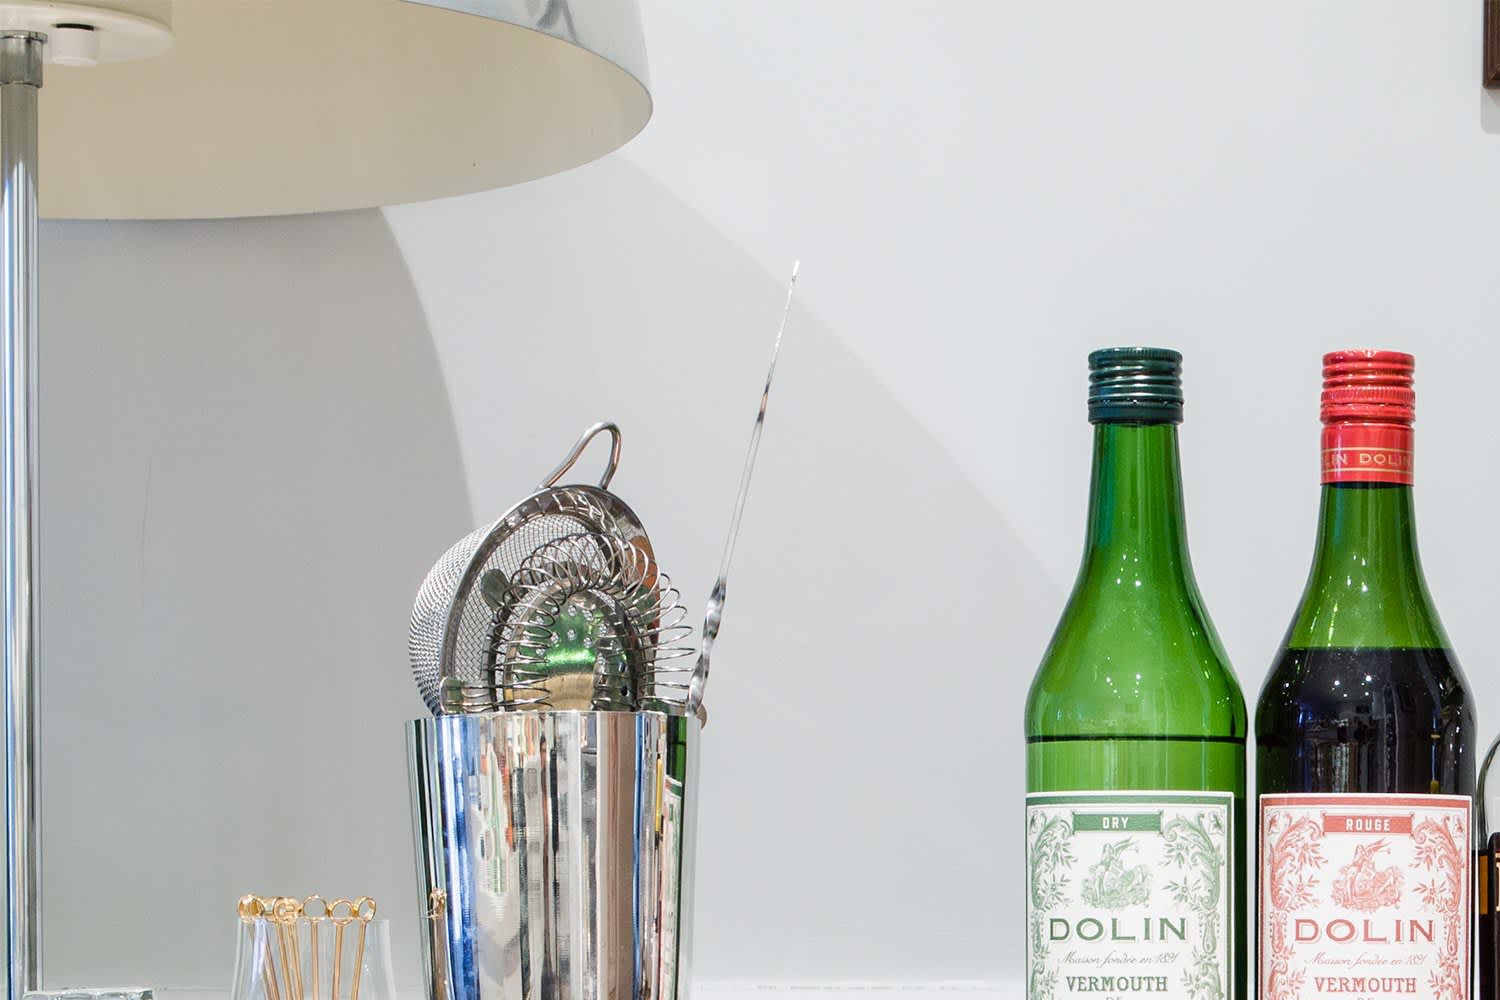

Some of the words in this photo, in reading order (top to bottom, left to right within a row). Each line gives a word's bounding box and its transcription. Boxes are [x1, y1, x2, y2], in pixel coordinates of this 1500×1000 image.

[1359, 453, 1411, 466] DOLIN
[1102, 816, 1129, 829] DRY
[1345, 818, 1391, 832] ROUGE
[1050, 917, 1186, 941] DOLIN
[1295, 918, 1434, 943] DOLIN
[1066, 976, 1168, 992] VERMOUTH
[1314, 977, 1417, 993] VERMOUTH
